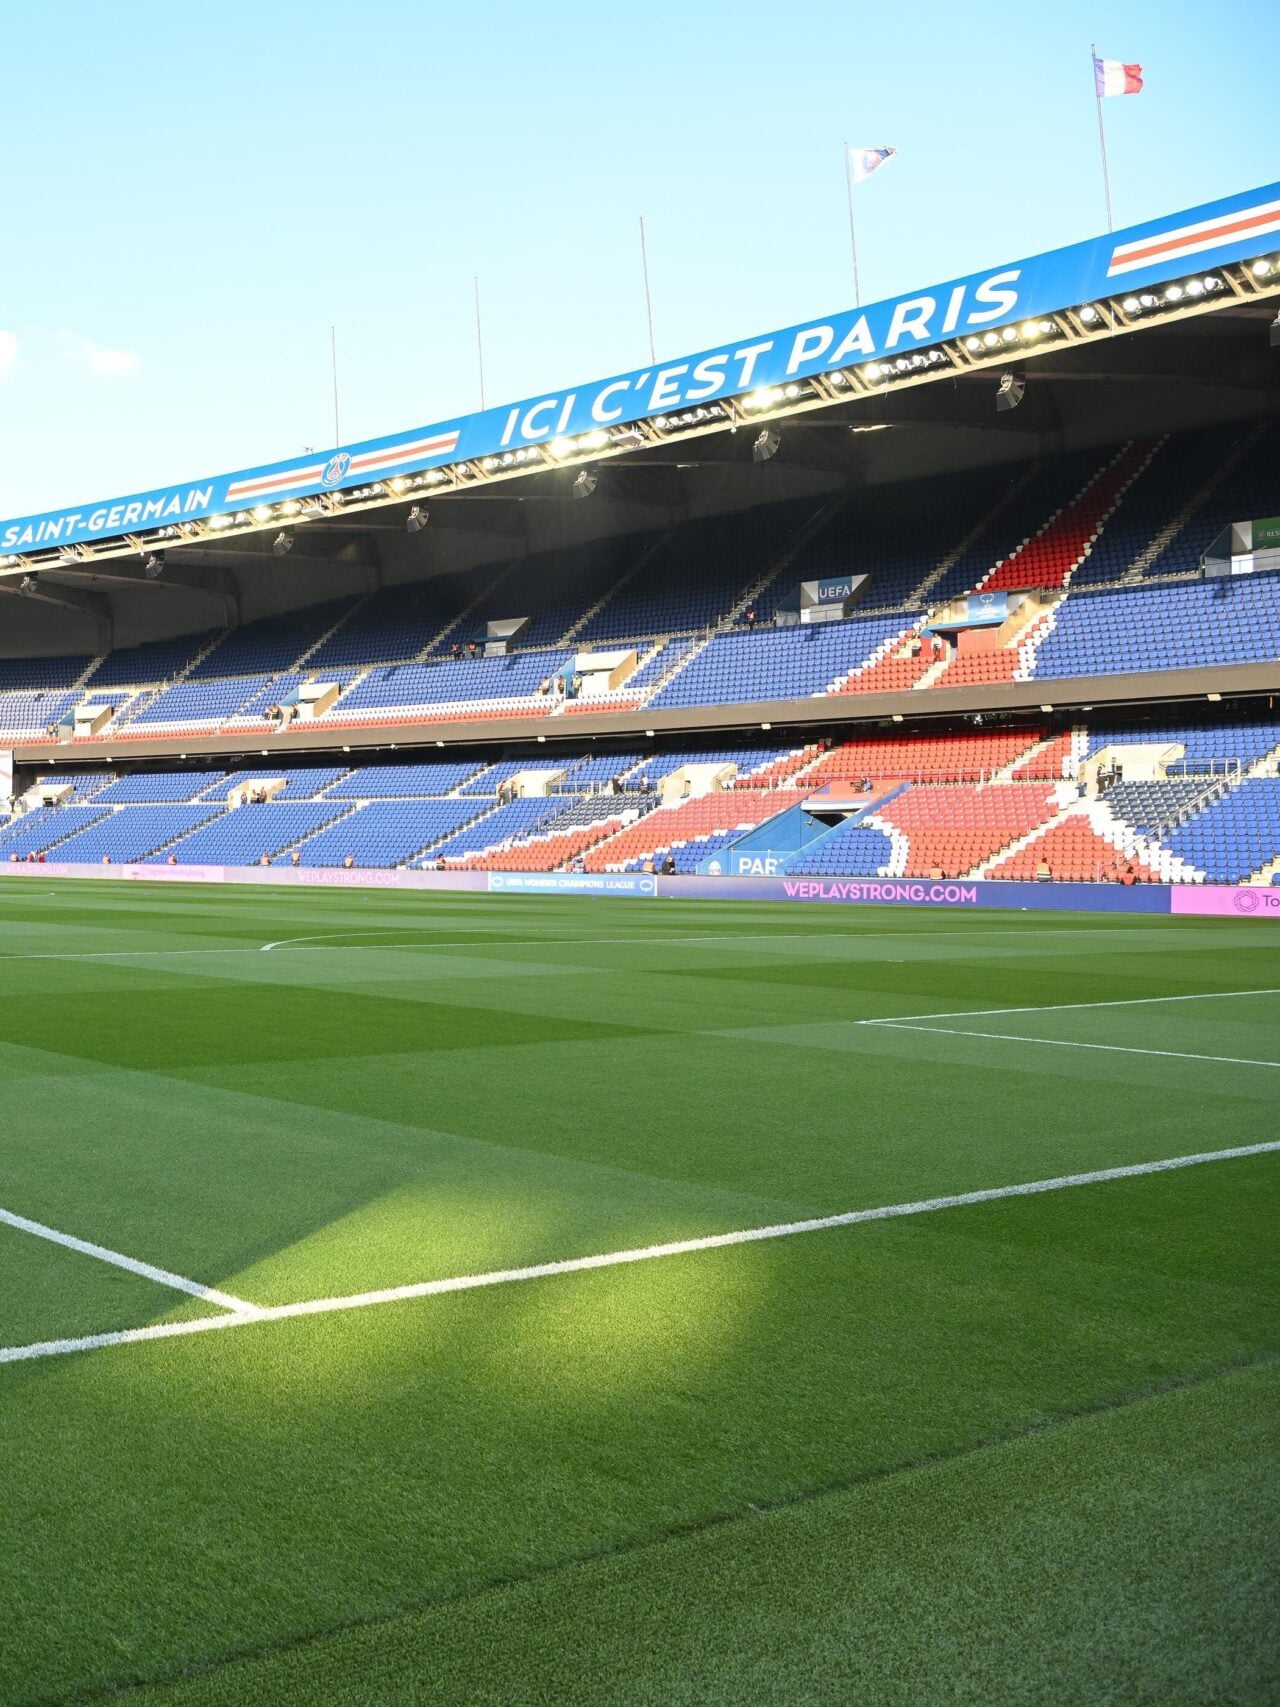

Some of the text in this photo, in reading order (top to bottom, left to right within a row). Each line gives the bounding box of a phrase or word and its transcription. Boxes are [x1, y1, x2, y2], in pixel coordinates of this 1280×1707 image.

[499, 270, 1022, 446] ICI C'EST PARIS
[0, 485, 214, 549] SAINT-GERMAIN
[819, 585, 851, 598] UEFA
[298, 870, 400, 885] WEPLAYSTRONG.COM
[558, 880, 604, 889] CHAMPIONS
[606, 881, 635, 889] LEAGUE
[783, 882, 977, 902] WEPLAYSTRONG.COM
[1262, 895, 1280, 907] To
